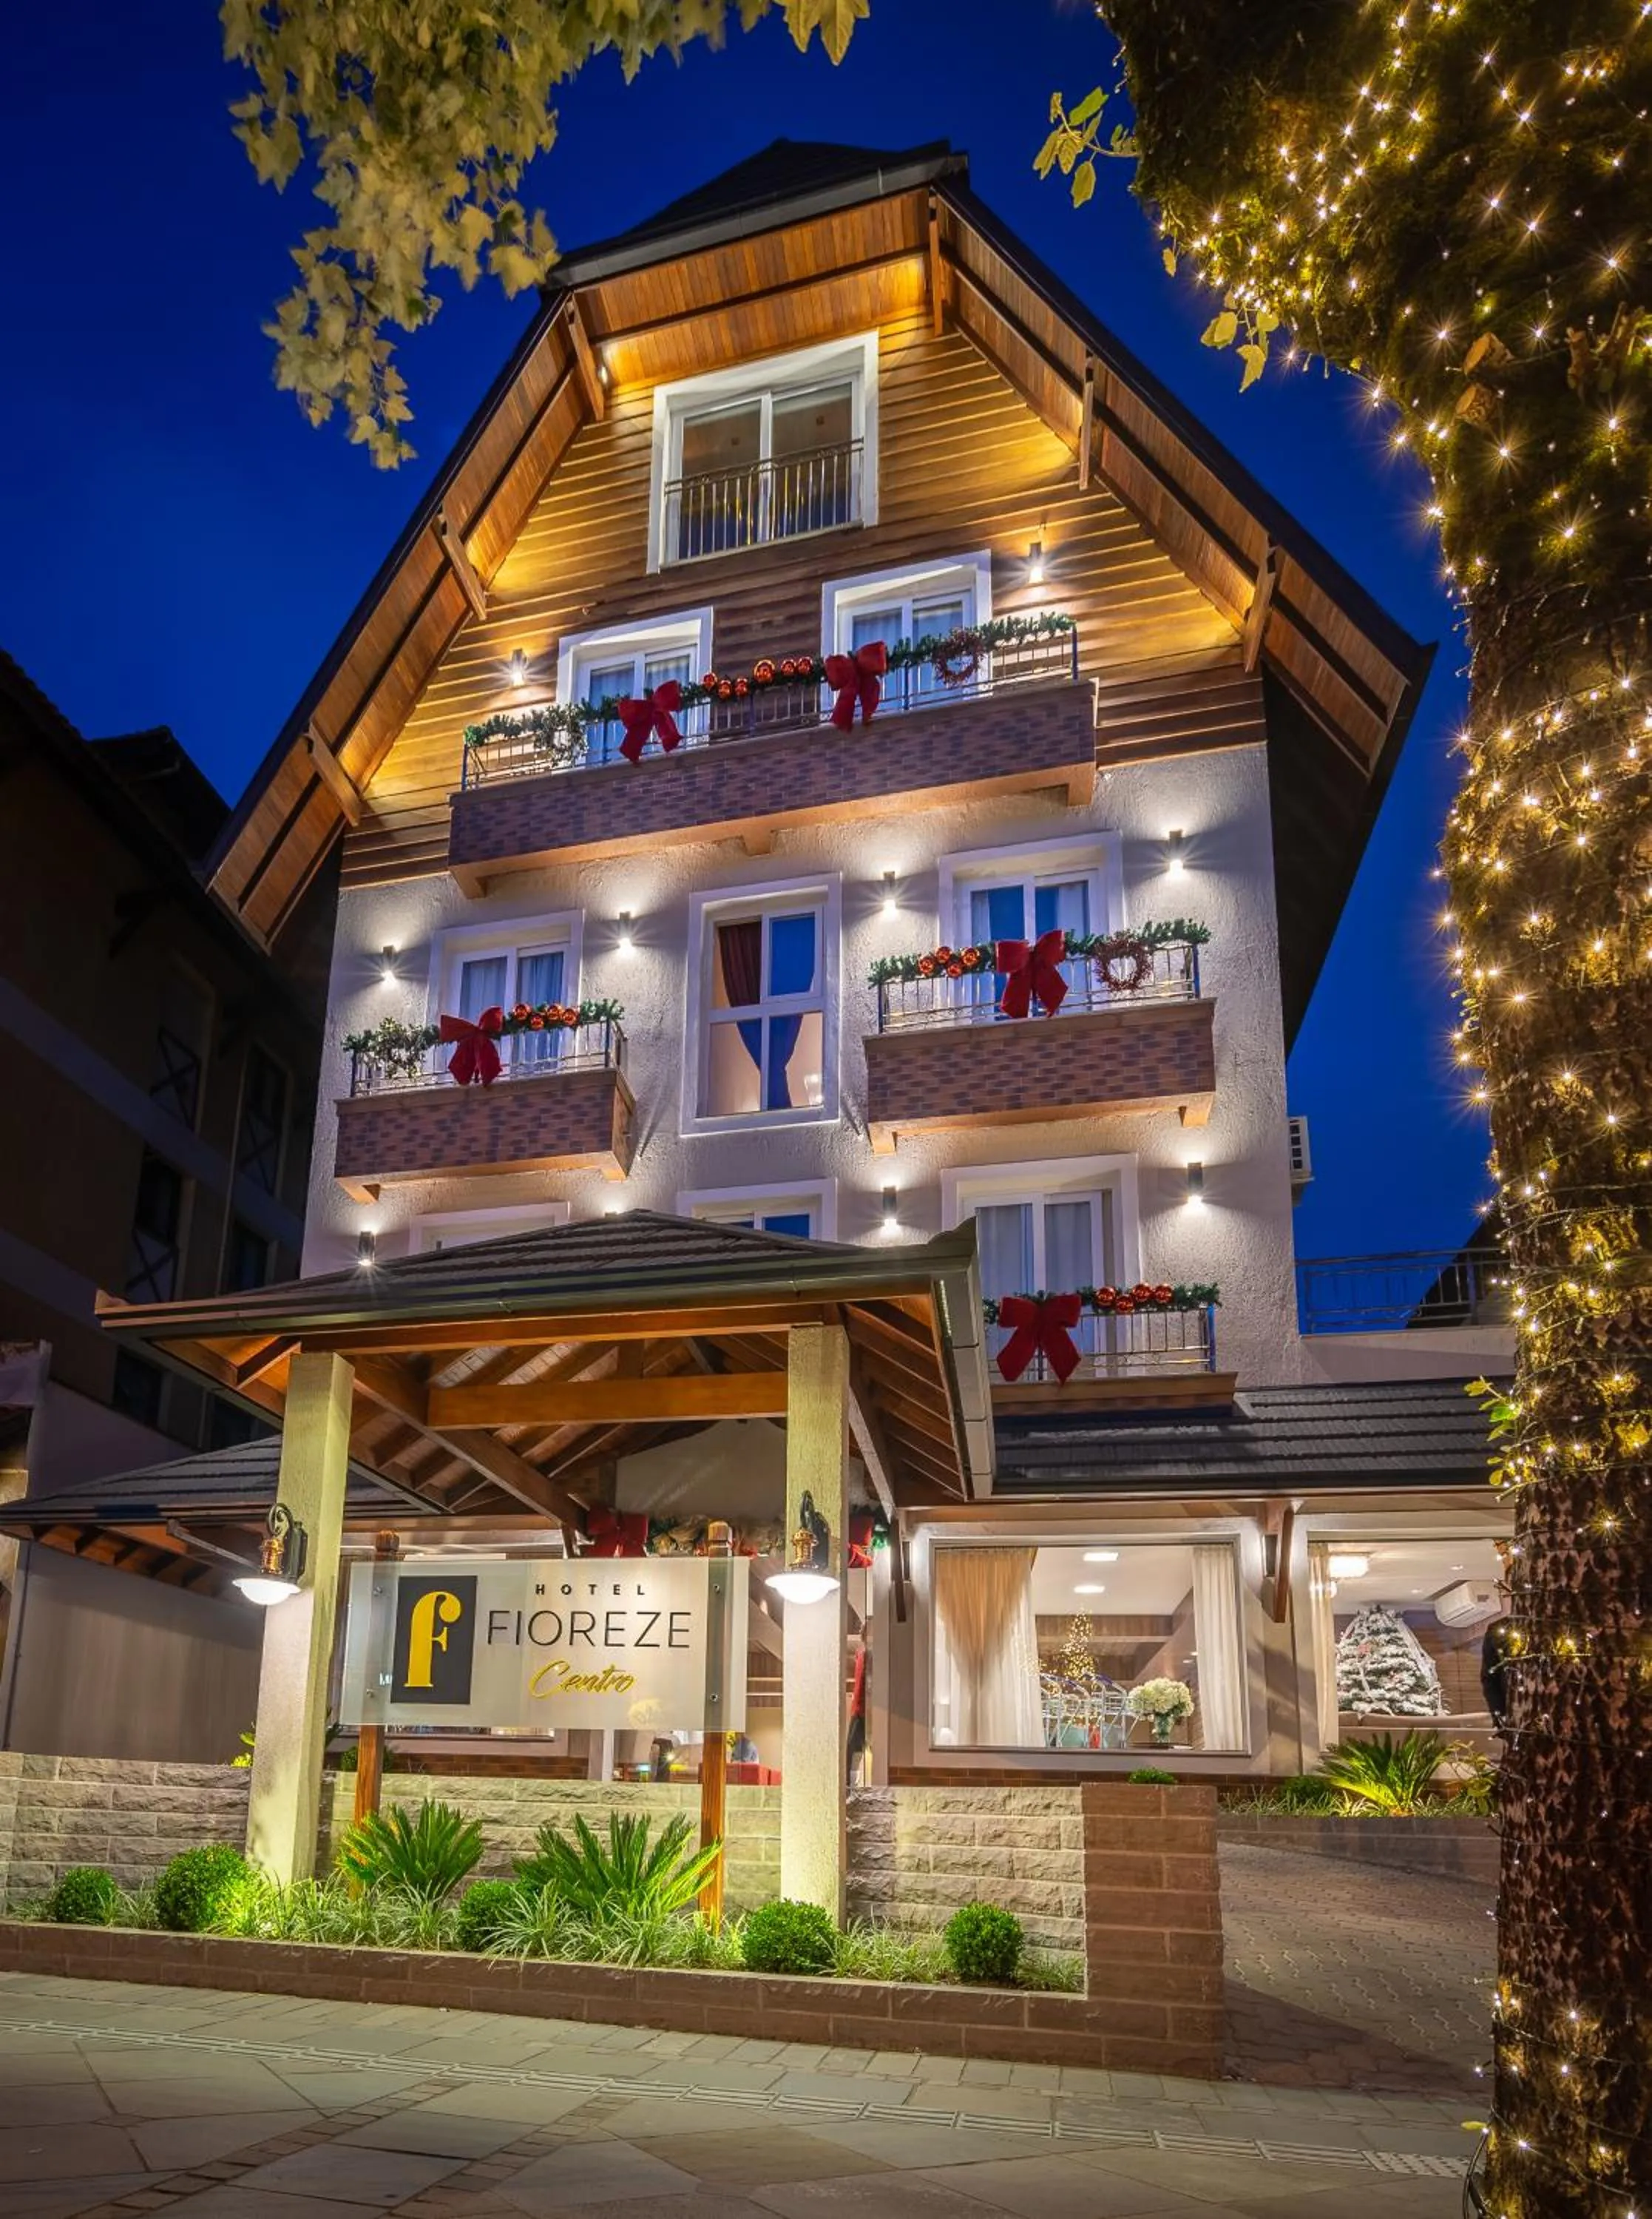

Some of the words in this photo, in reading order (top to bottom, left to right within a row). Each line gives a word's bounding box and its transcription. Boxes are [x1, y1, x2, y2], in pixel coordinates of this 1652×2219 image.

[535, 1583, 646, 1596] HOTEL
[487, 1609, 692, 1649] FIOREZE
[528, 1659, 635, 1700] Centro
